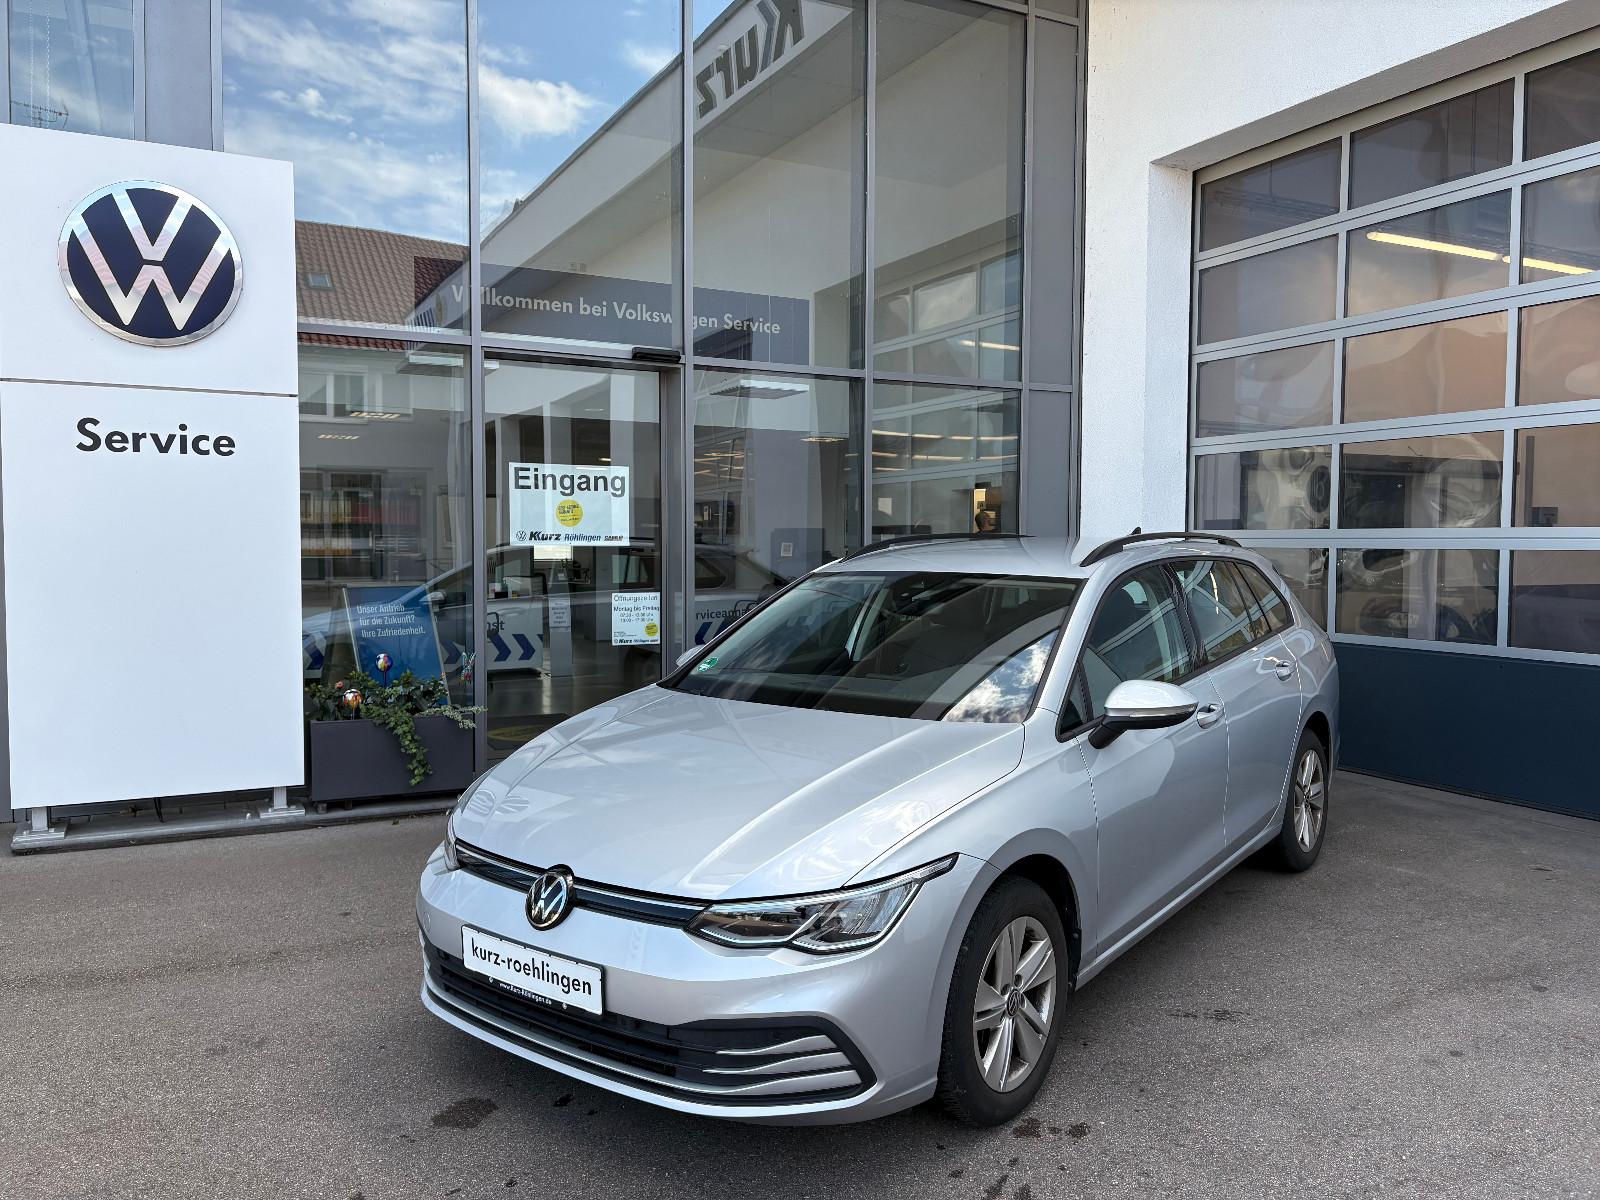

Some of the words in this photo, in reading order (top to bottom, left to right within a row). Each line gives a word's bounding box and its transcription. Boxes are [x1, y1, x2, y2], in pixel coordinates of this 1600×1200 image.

[451, 284, 573, 314] Wllkommen
[579, 297, 607, 317] bei
[612, 301, 718, 330] Volkswen
[723, 313, 781, 334] Service
[76, 417, 236, 457] Service
[513, 466, 626, 497] Eingang
[529, 531, 561, 541] Kurz
[564, 533, 601, 542] Röhlingen
[356, 605, 378, 614] Unser
[379, 603, 405, 613] Antrieb
[359, 617, 370, 627] für
[371, 616, 383, 625] die
[384, 614, 415, 625] Zukunft?
[361, 629, 376, 638] Ihre
[377, 625, 426, 637] Zufriedenheit.
[471, 937, 592, 996] kurz-roehlingen
